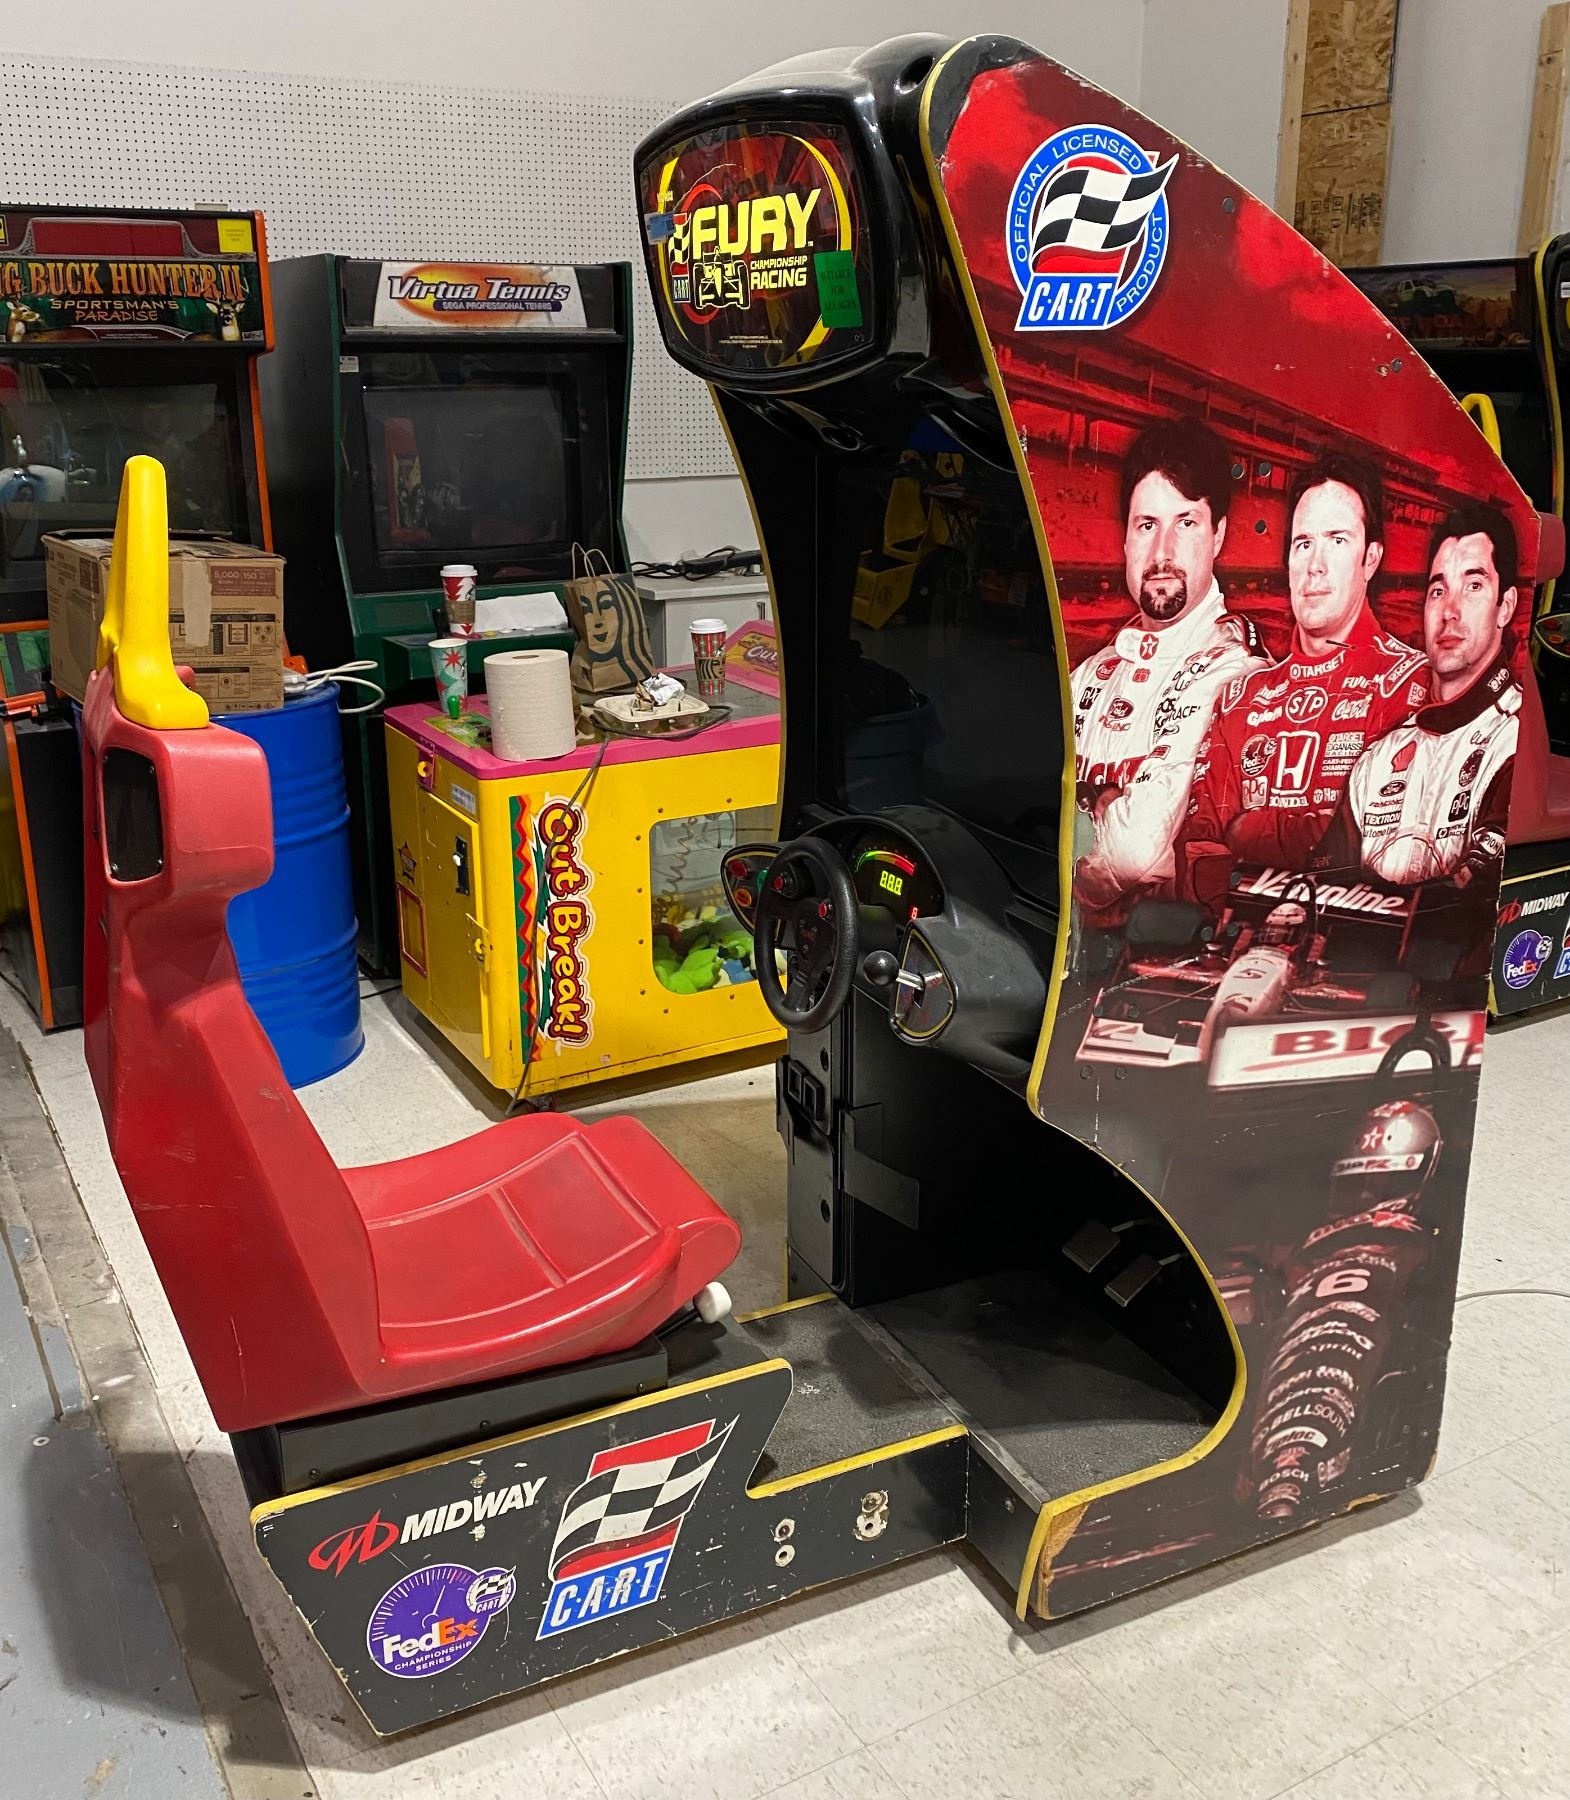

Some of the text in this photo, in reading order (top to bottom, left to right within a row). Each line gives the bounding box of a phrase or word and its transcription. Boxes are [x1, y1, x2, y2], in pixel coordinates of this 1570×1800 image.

[1014, 133, 1142, 263] OFFICIAL LICENSED
[692, 188, 822, 260] FURY
[750, 256, 809, 270] CHAMPIONSHIP
[1116, 212, 1163, 313] PRODUCT
[28, 262, 101, 296] BUCK
[110, 263, 220, 299] HUNTER
[388, 275, 571, 302] Virtua Tennis
[750, 267, 808, 291] RACING
[51, 300, 179, 310] SPORTSMAN'S
[75, 310, 159, 322] PARADISE
[442, 301, 553, 311] SEGA PROFESSIONAL TENNIS
[1300, 650, 1346, 678] TARGET
[1289, 690, 1324, 716] STP
[1365, 812, 1401, 826] TEXTRON
[1520, 891, 1570, 917] MIDWAY
[551, 903, 587, 1039] Break!
[1507, 959, 1538, 979] FedEx
[1315, 1268, 1371, 1298] 6
[1271, 1403, 1346, 1438] BELLSOUTH
[1258, 1468, 1309, 1492] BOSCH
[400, 1476, 548, 1545] MIDWAY
[382, 1616, 479, 1665] FedEx
[394, 1640, 473, 1671] CHAMPIONSHIP
[415, 1656, 452, 1673] SERIES
